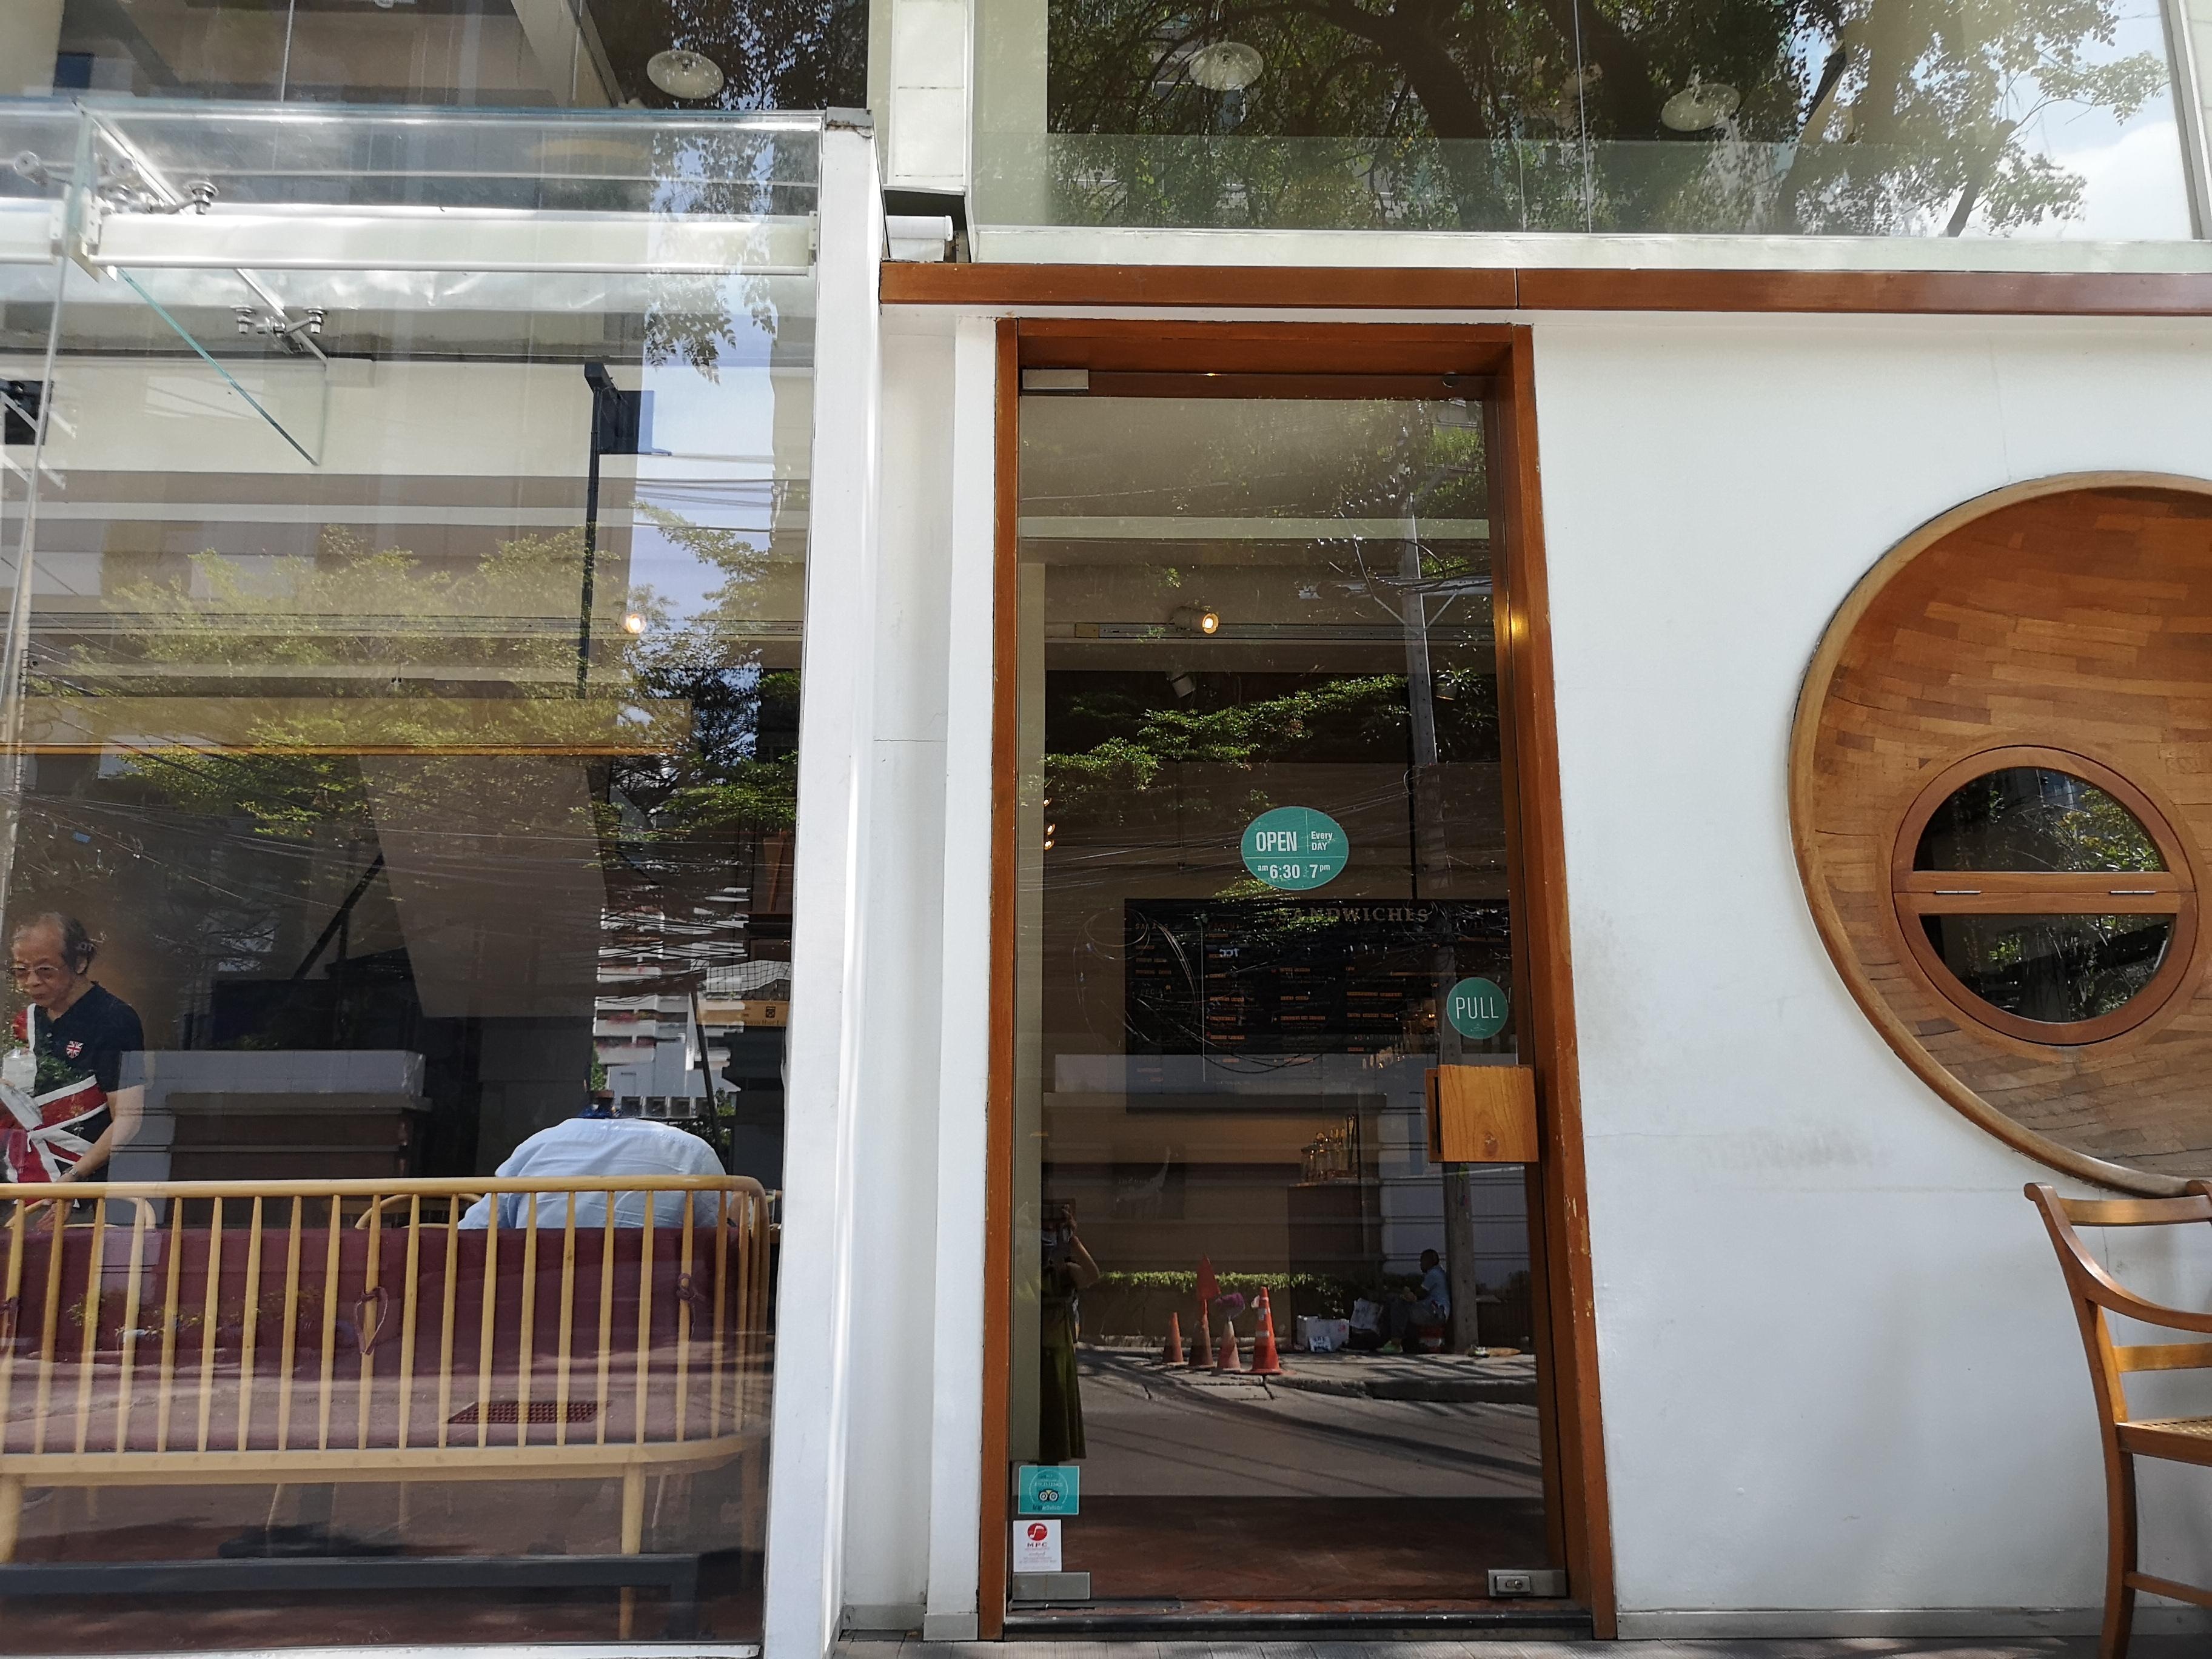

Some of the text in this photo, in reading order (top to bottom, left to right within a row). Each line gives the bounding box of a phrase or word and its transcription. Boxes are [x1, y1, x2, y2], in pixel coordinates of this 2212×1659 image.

[1256, 831, 1297, 852] OPEN
[1311, 831, 1333, 841] Every
[1312, 842, 1327, 851] DAY
[1309, 864, 1318, 879] 7
[1455, 996, 1500, 1019] PULL
